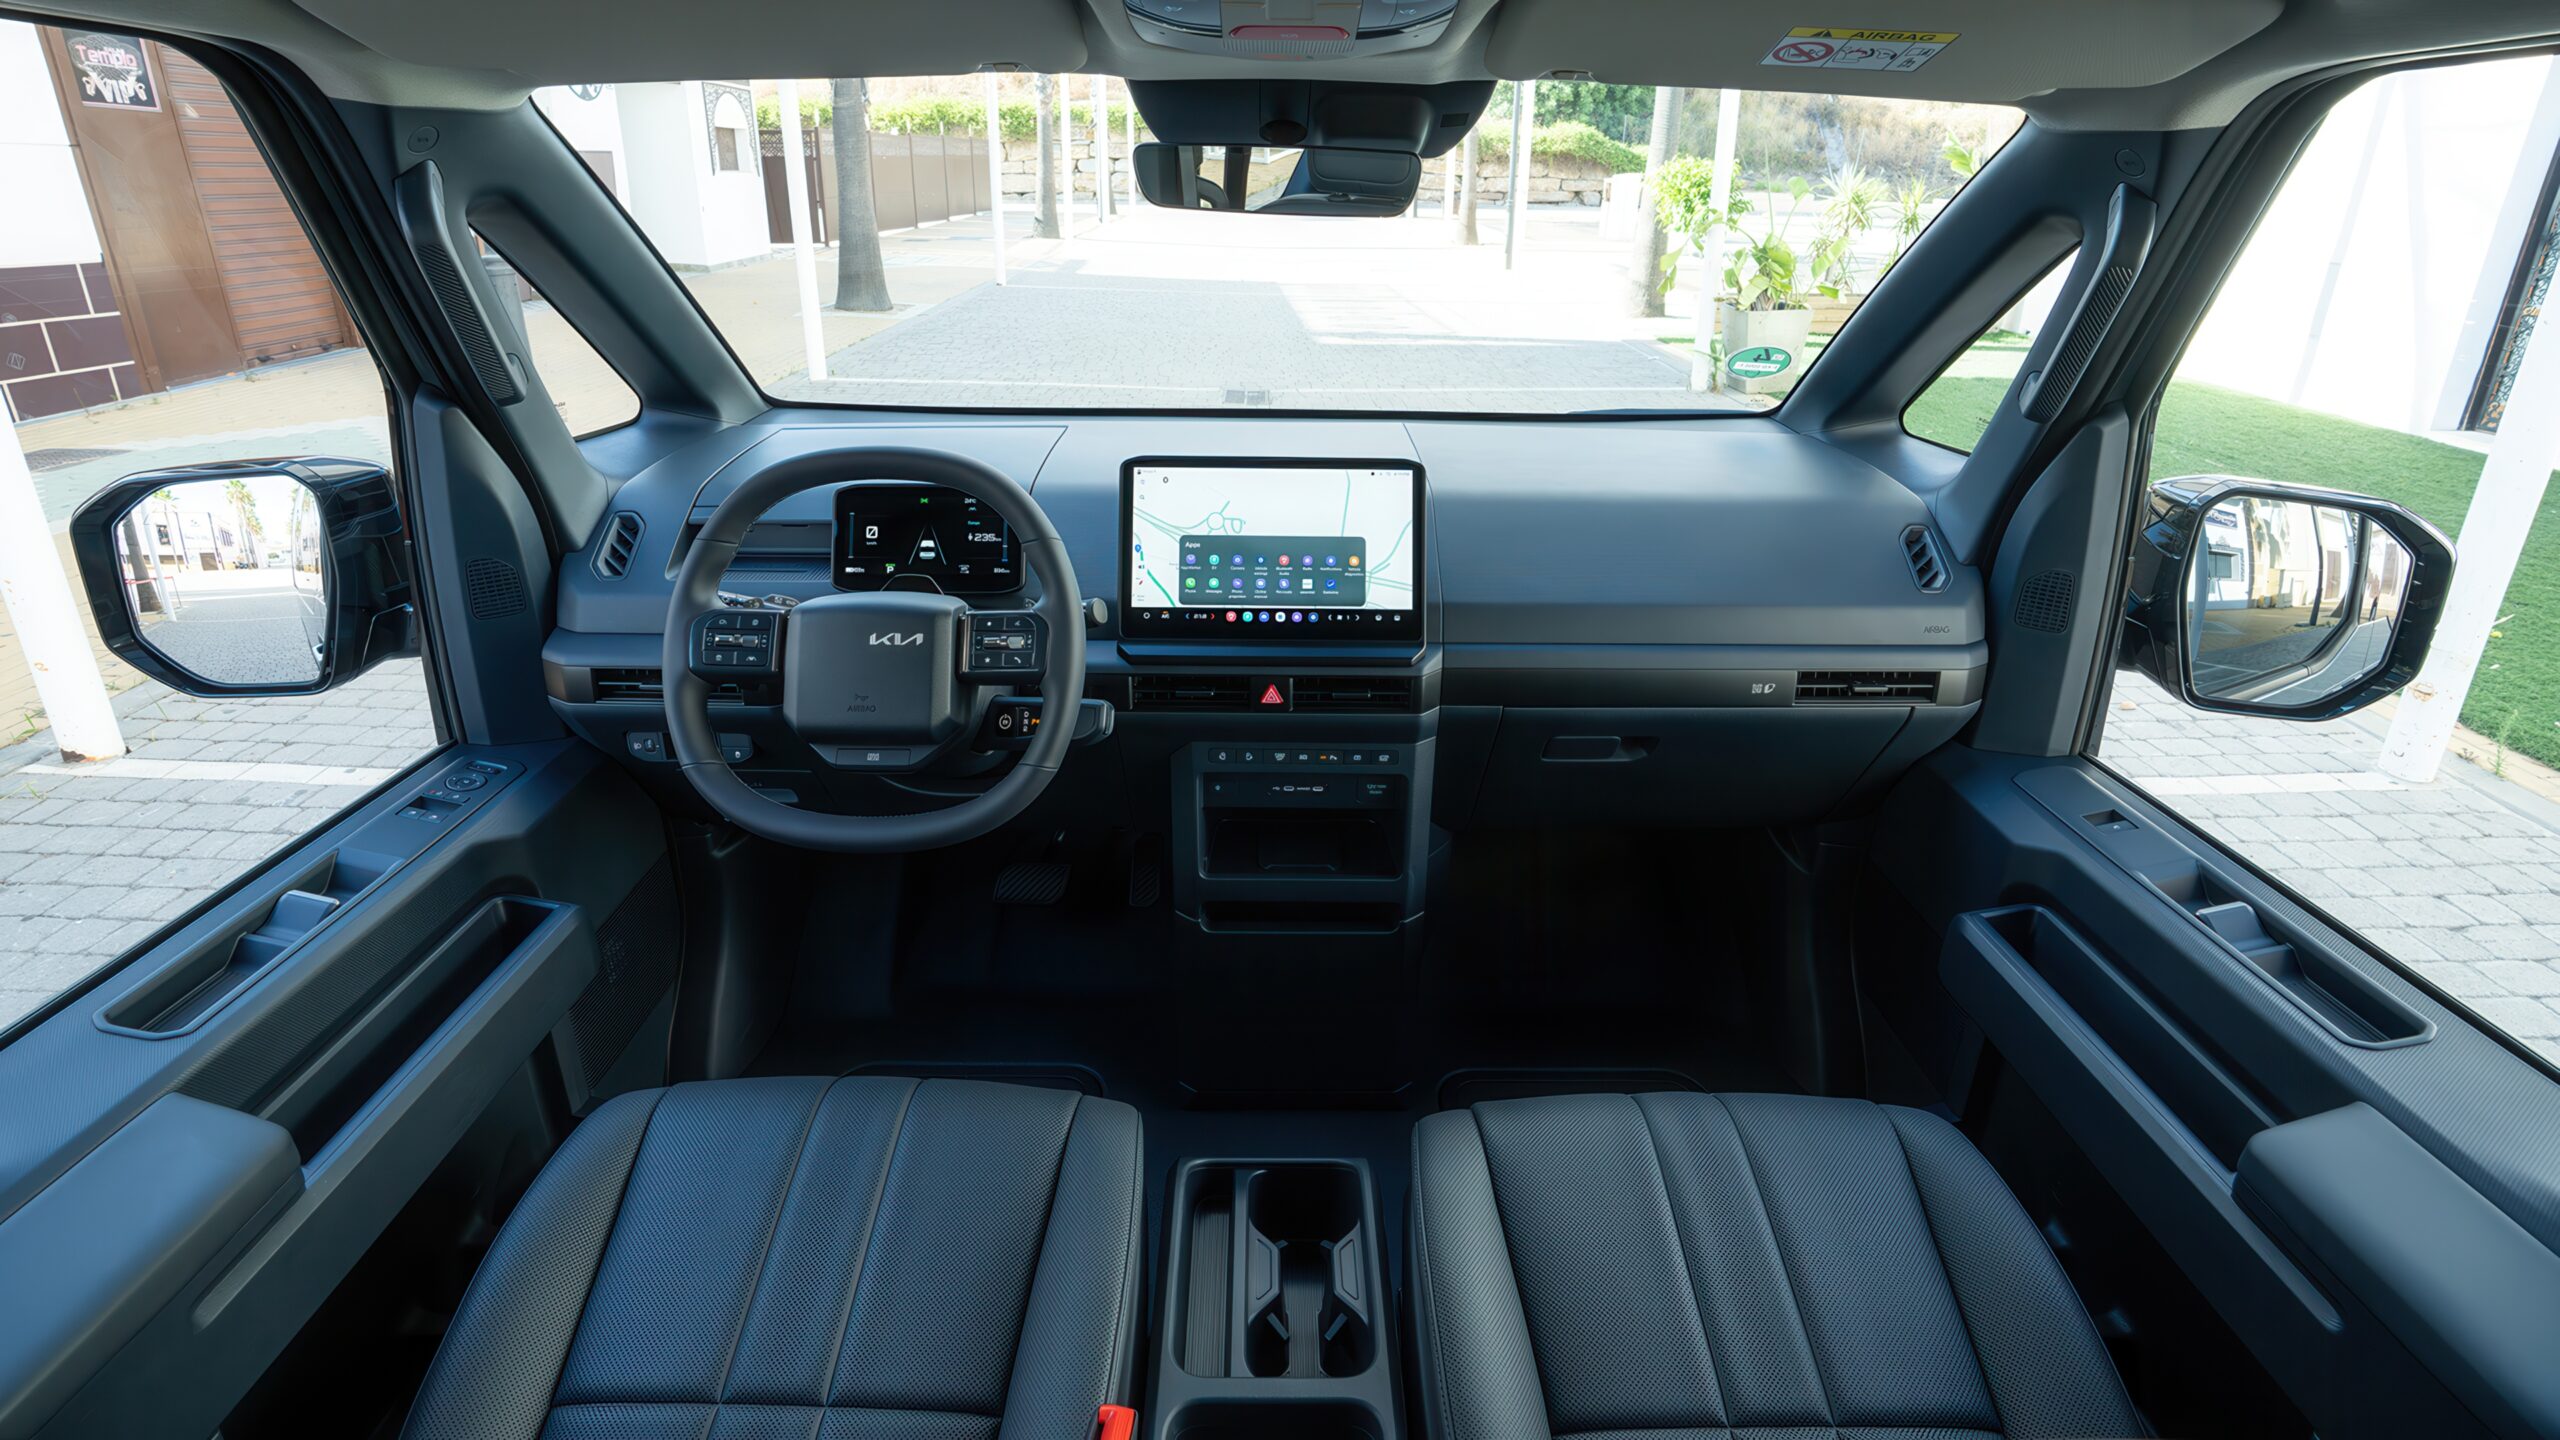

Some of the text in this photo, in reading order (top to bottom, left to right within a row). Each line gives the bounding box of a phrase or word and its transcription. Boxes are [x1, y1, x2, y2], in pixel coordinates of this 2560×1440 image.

[1850, 31, 1937, 41] AIRBAG
[75, 45, 138, 69] Templo
[866, 526, 878, 538] 0
[974, 533, 996, 542] 235
[886, 566, 895, 574] P
[869, 632, 924, 646] KIA
